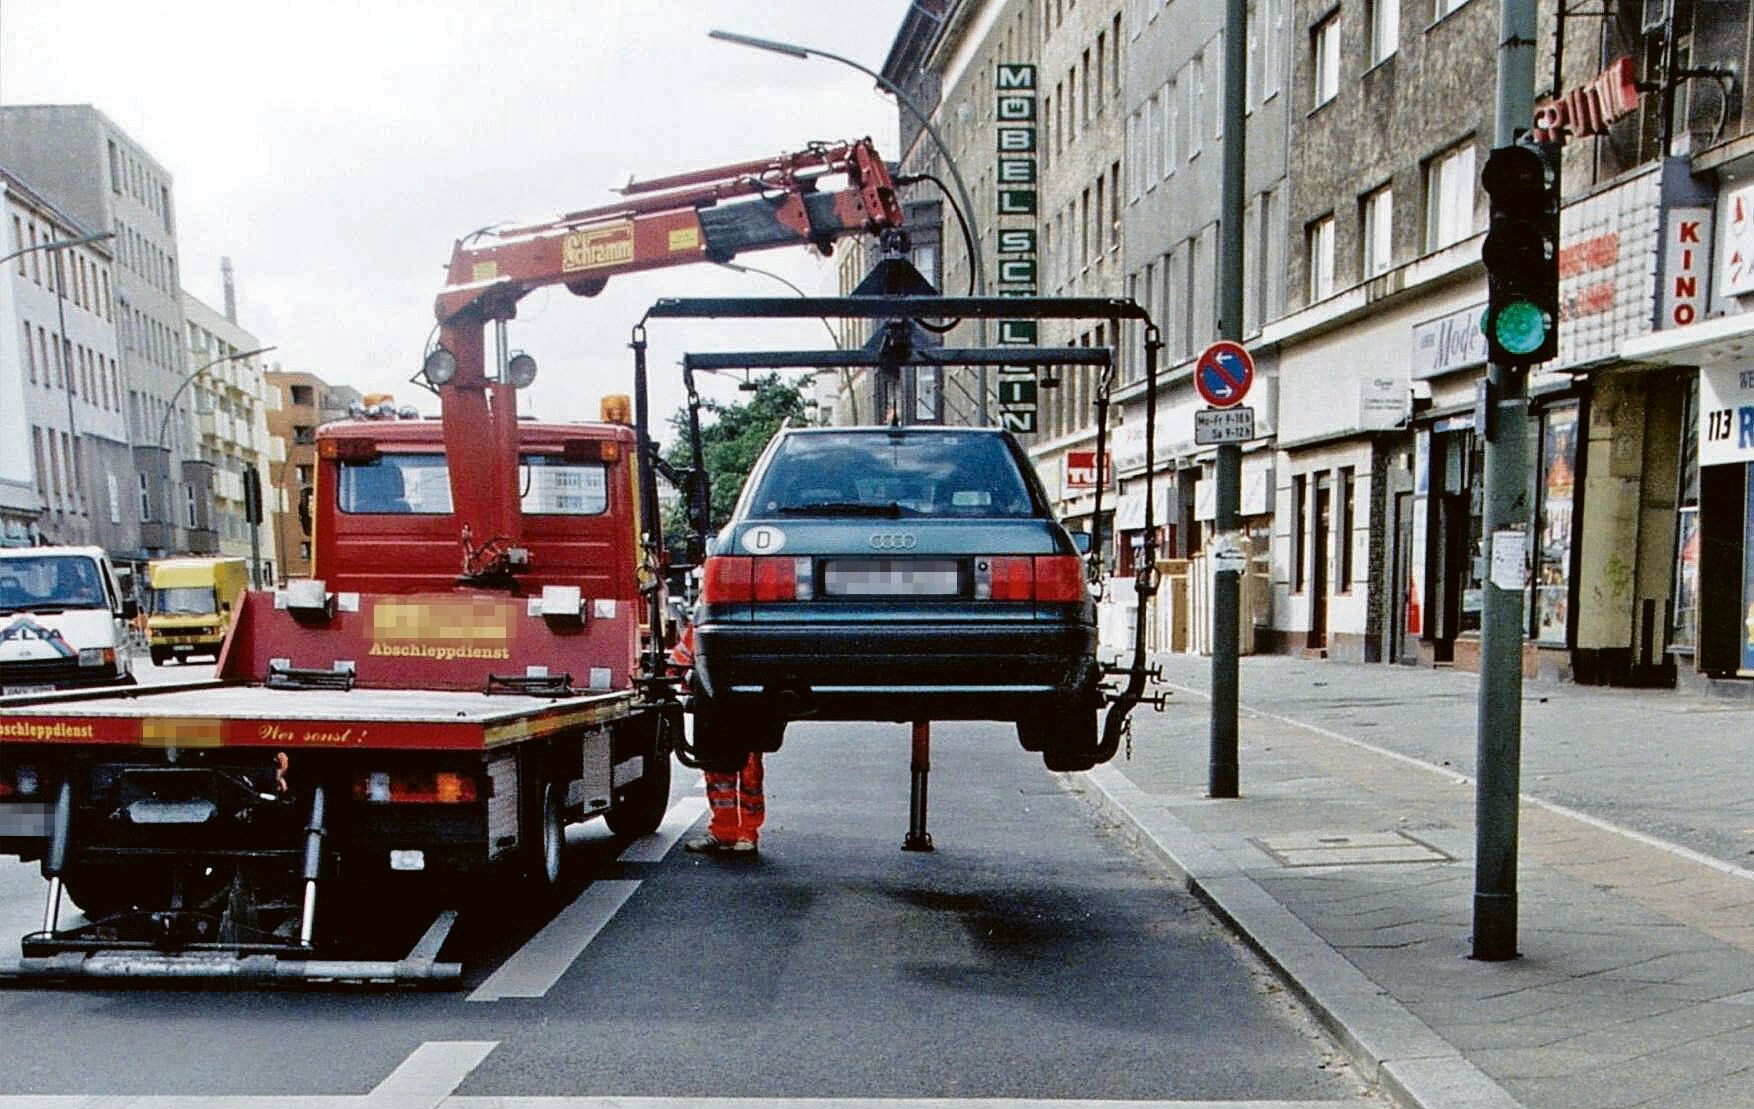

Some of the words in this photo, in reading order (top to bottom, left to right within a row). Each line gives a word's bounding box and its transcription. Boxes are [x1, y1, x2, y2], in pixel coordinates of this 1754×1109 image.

[999, 66, 1032, 213] MÖBEL
[1673, 221, 1701, 326] KINO
[1708, 408, 1732, 441] 113
[757, 531, 771, 549] D
[369, 643, 510, 660] Abschleppdienst
[303, 729, 352, 742] sonst
